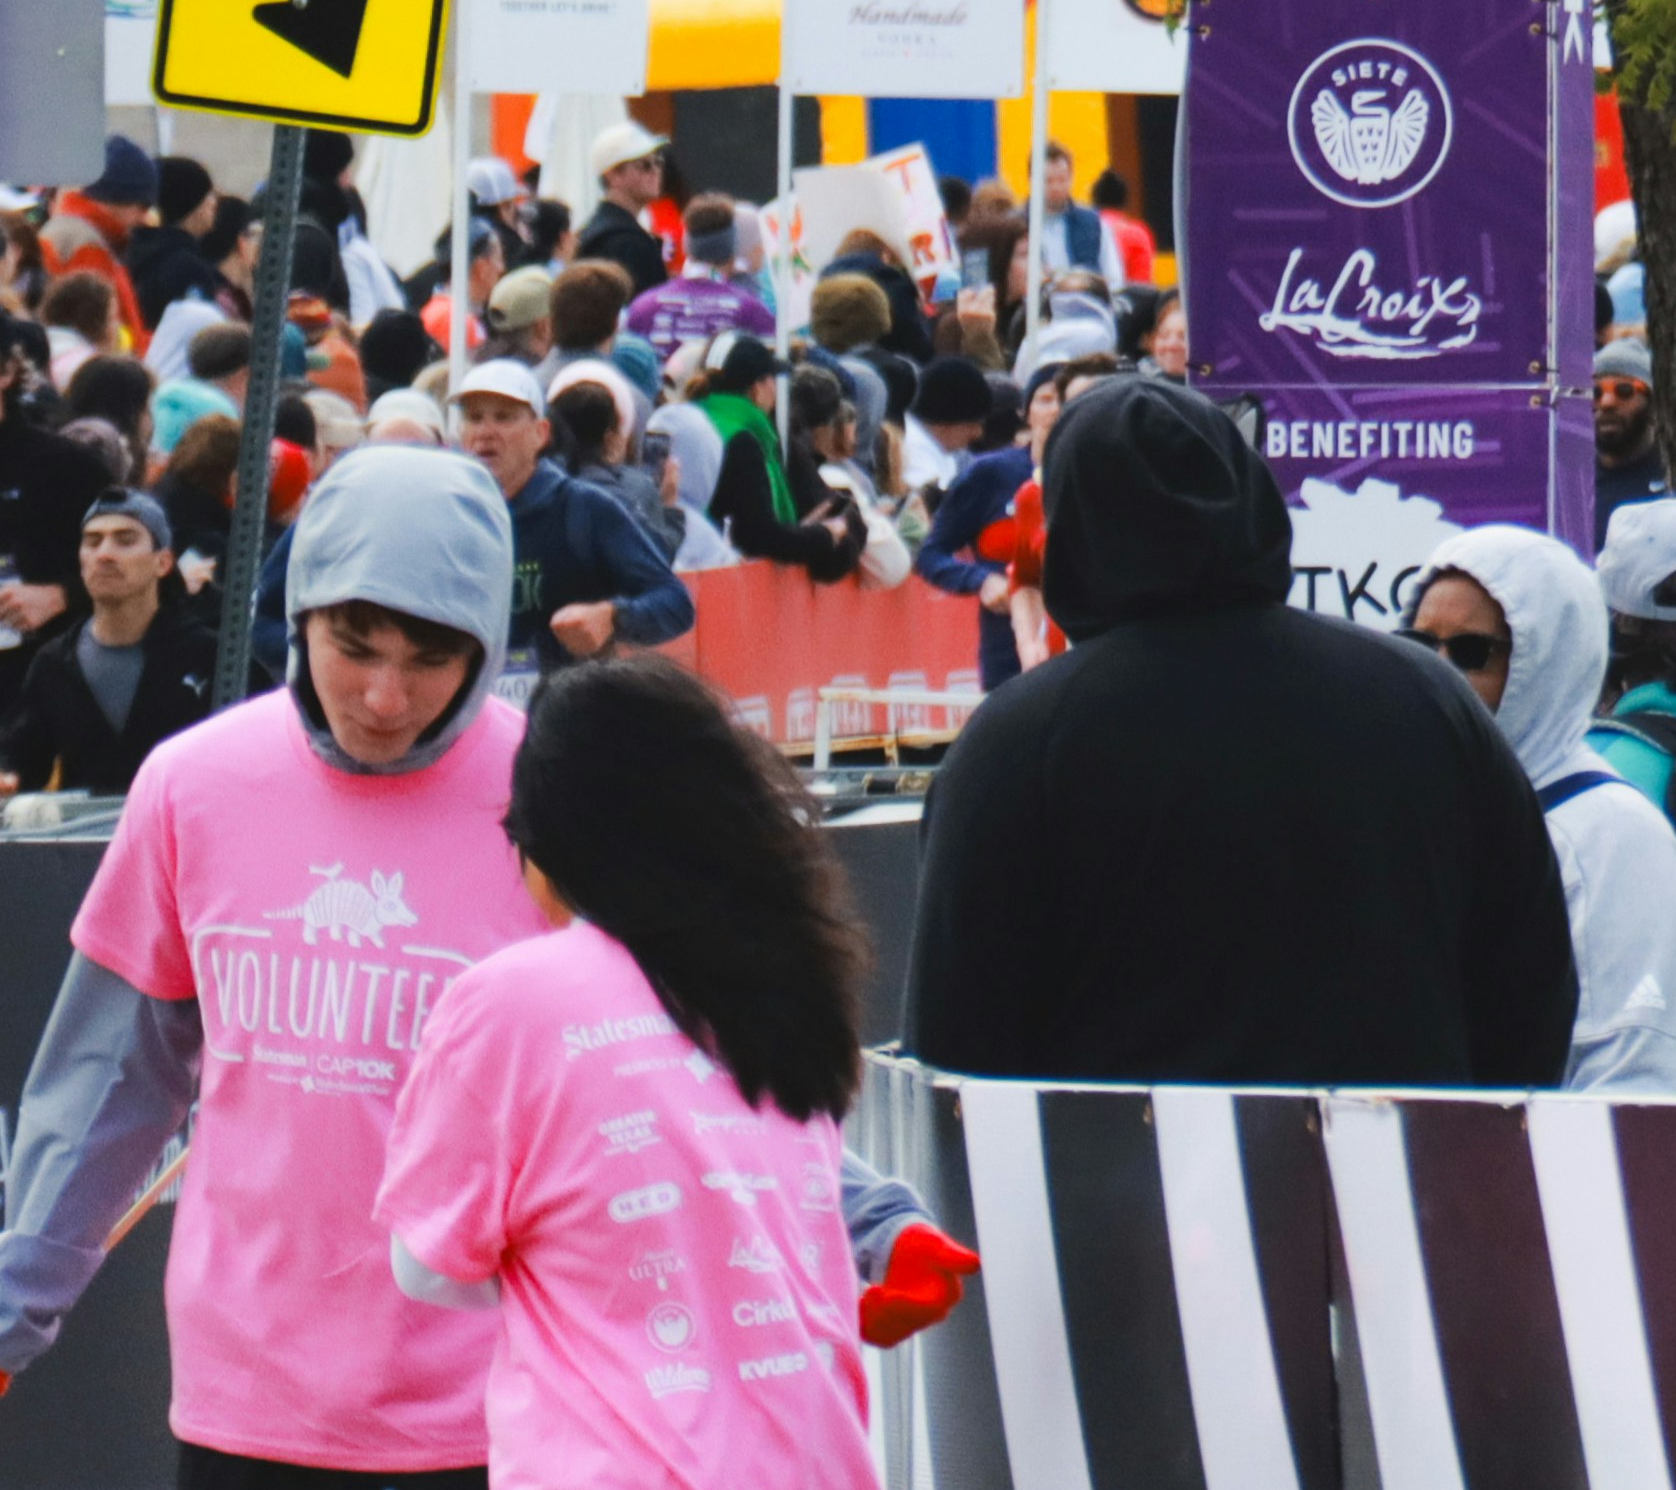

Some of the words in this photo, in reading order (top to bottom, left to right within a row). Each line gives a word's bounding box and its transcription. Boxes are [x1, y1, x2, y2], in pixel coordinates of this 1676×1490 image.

[849, 0, 967, 25] Handmade
[1330, 61, 1408, 88] SIETE
[1266, 421, 1474, 460] BENEFITING
[211, 947, 457, 1050] VOLUNTEE
